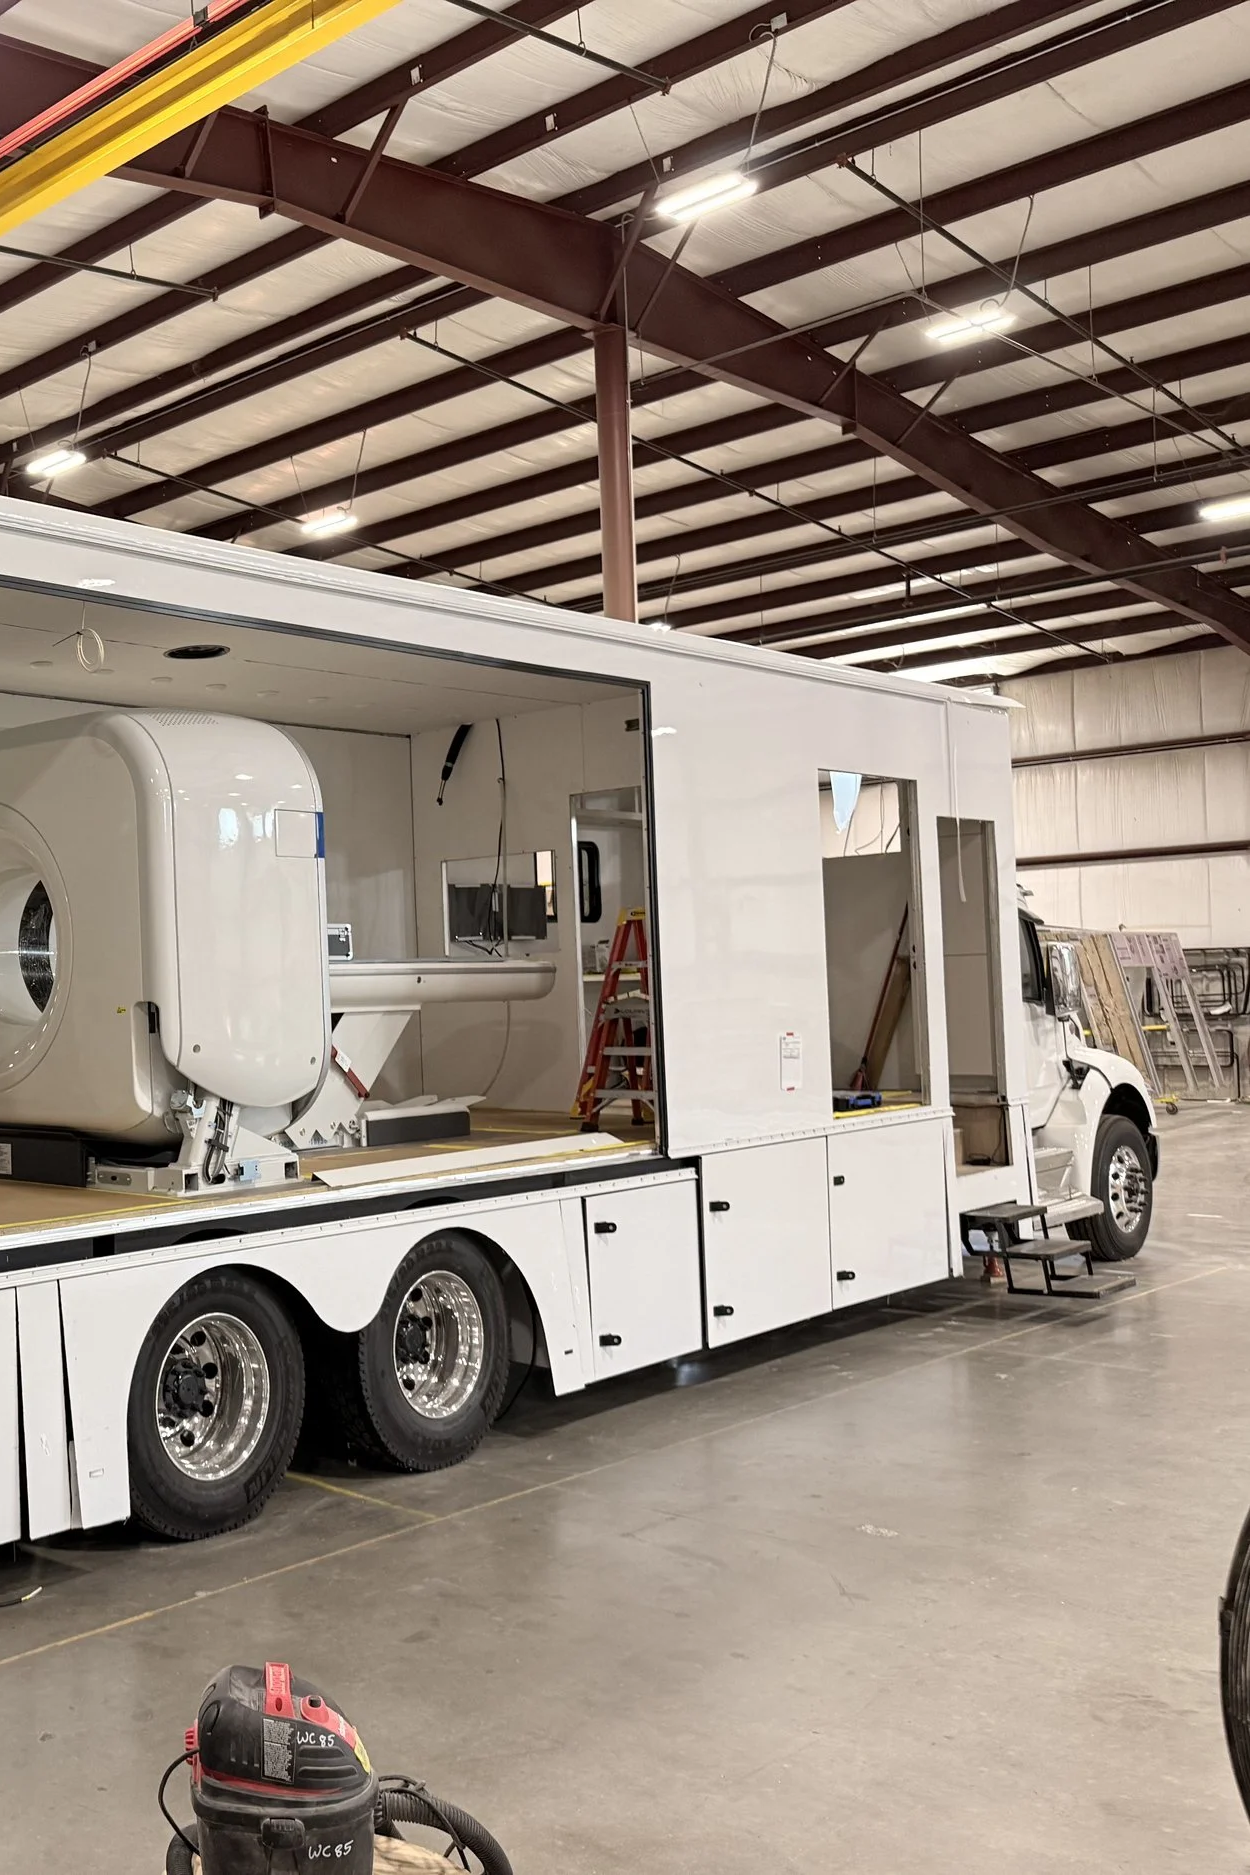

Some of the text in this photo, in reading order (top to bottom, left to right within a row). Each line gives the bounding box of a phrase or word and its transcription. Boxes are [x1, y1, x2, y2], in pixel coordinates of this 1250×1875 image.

[296, 1731, 336, 1748] WC 85
[308, 1839, 354, 1860] WC 85
